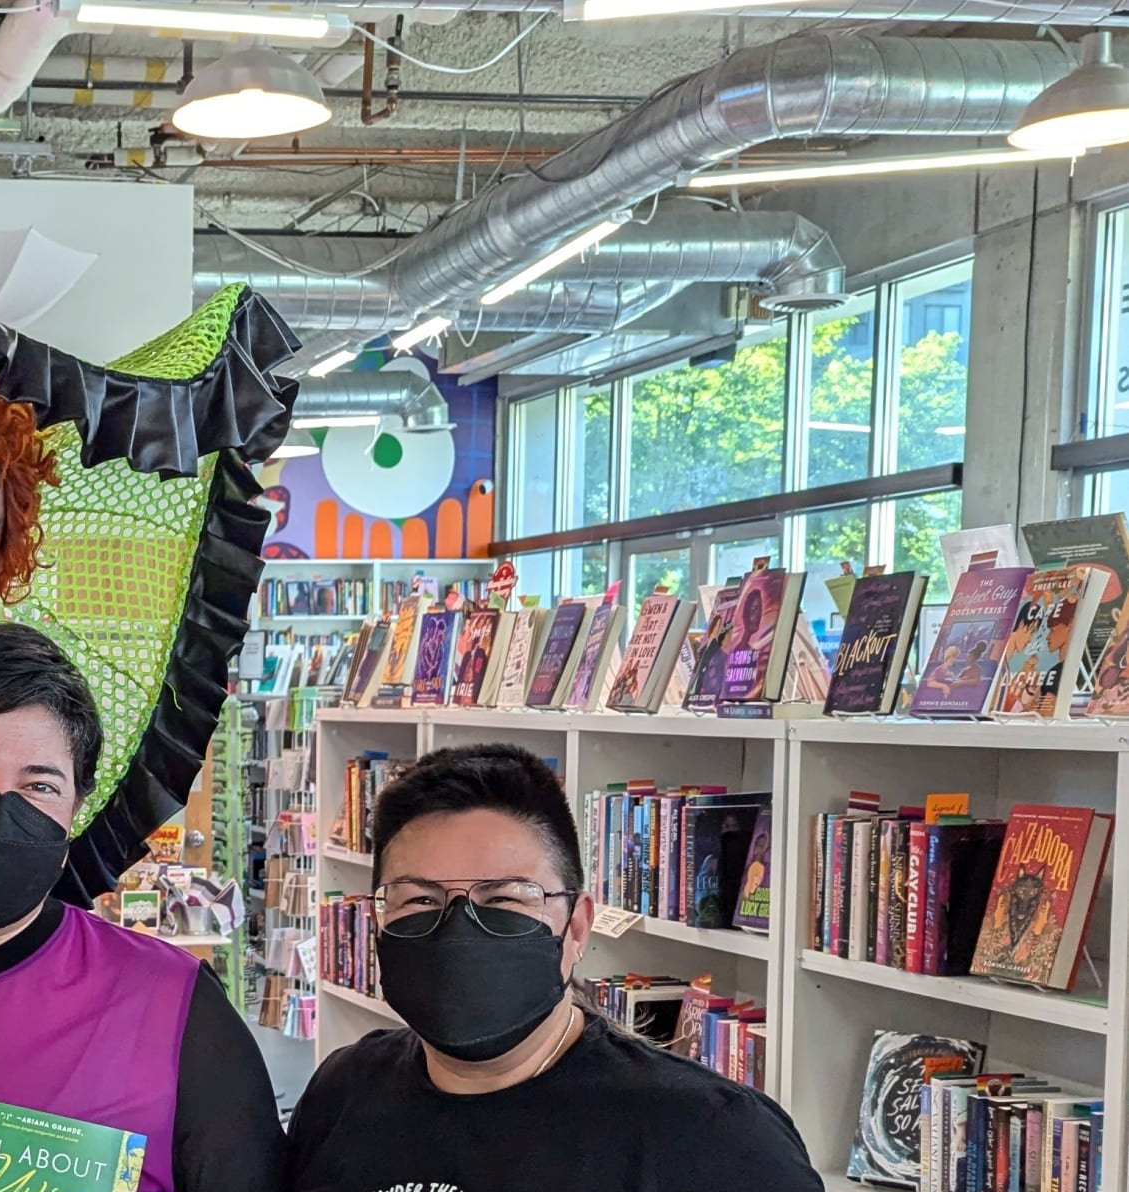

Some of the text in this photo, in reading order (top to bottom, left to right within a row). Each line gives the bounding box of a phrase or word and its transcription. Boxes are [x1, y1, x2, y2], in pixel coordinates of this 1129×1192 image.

[980, 579, 994, 587] THE
[1033, 582, 1056, 592] EMERY
[992, 584, 1018, 605] Guy
[950, 606, 1008, 617] DOESN'T EXIST
[643, 633, 656, 644] NOT
[639, 646, 655, 658] LOVE
[734, 652, 752, 664] SONG
[834, 629, 897, 677] BLACKOUT
[726, 669, 757, 681] SALVATION
[997, 822, 1074, 891] CAZADORA
[907, 855, 919, 940] GAY CLUB!
[18, 1145, 107, 1181] ABOUT
